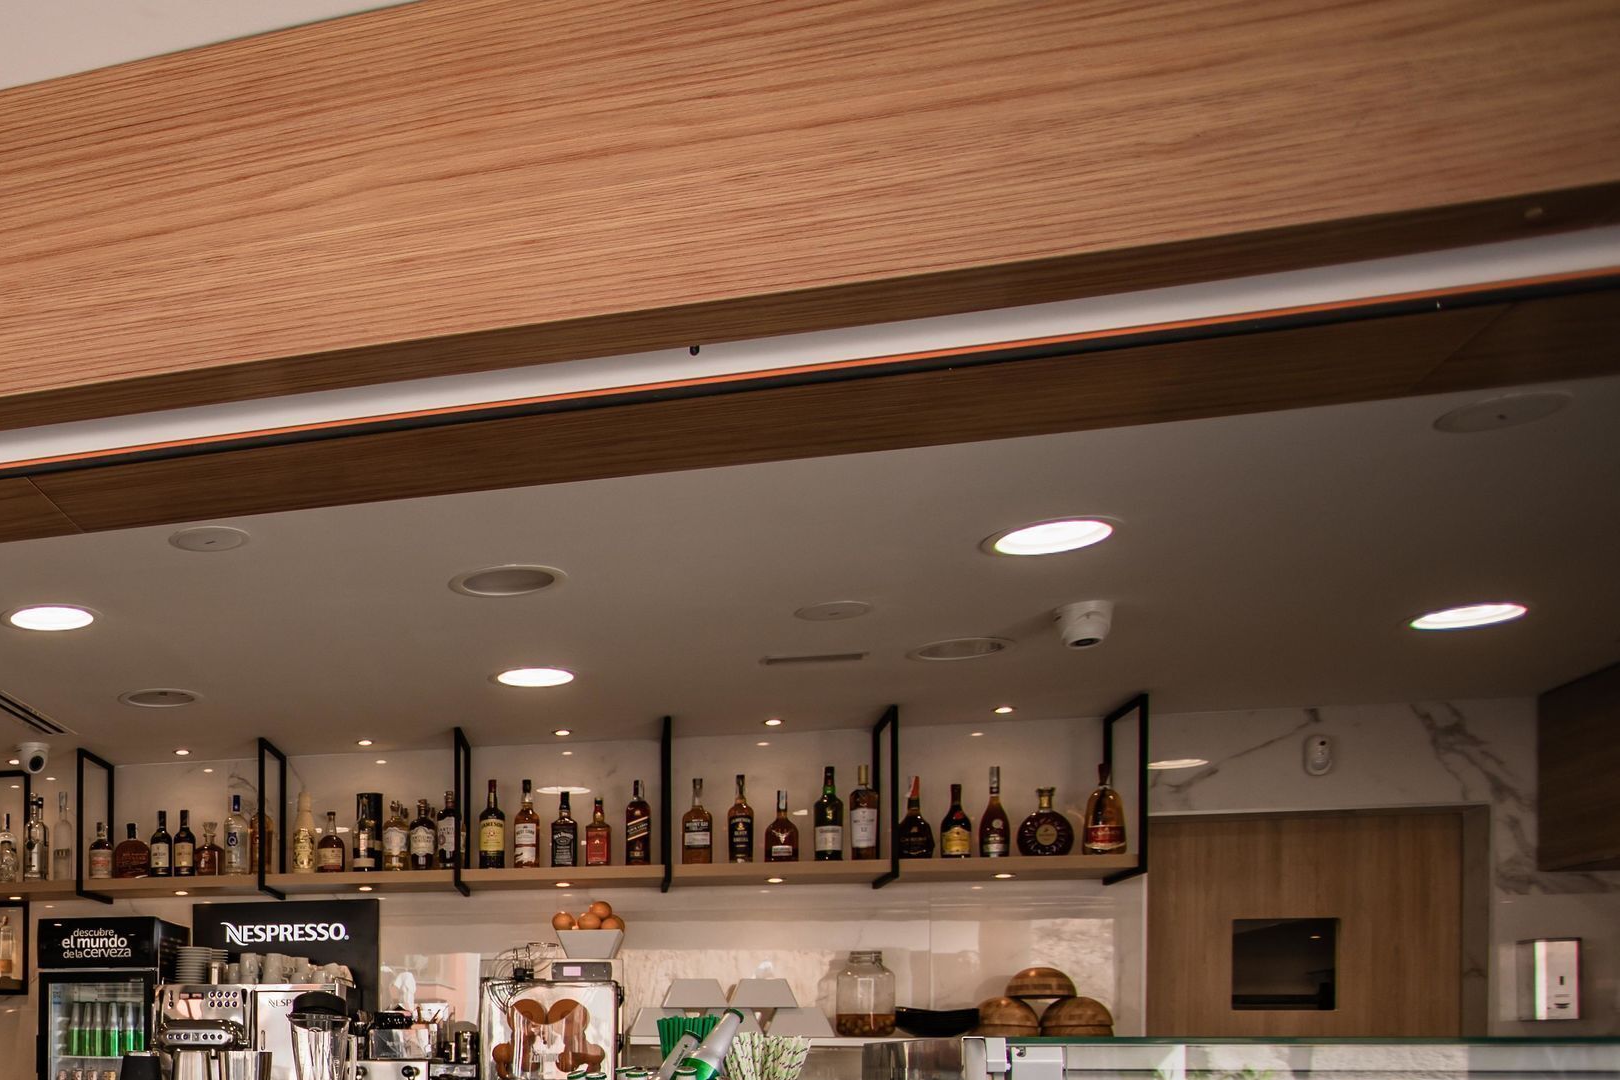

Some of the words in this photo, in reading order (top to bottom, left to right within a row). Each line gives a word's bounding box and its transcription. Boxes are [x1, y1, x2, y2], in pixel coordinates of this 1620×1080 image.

[73, 928, 114, 937] descubre
[62, 935, 75, 948] el
[77, 934, 127, 948] mundo
[63, 950, 74, 958] de
[75, 949, 82, 958] la
[83, 947, 132, 957] cerveza
